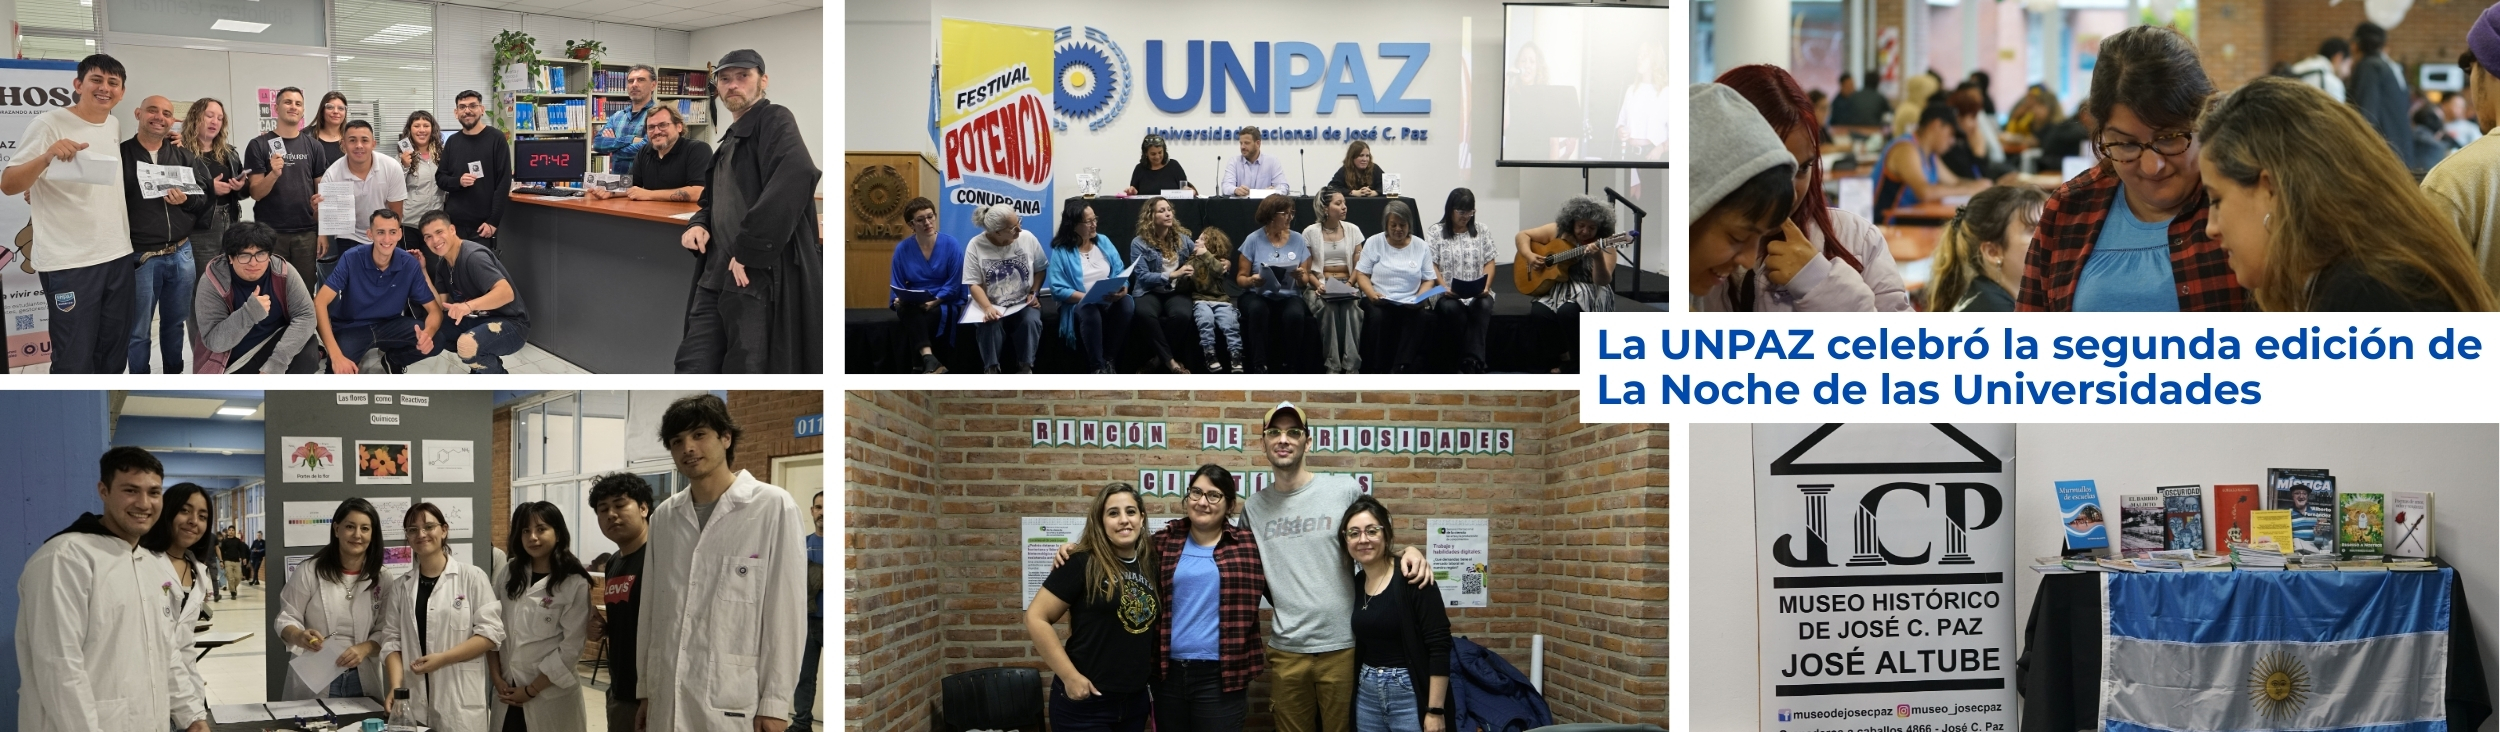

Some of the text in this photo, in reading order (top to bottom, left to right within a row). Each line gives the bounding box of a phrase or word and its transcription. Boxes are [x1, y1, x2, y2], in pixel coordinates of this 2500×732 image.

[1145, 39, 1432, 114] UNPAZ
[957, 66, 1030, 109] FESTIVAL
[261, 106, 270, 114] NO
[945, 94, 1052, 185] POTENCIA
[1257, 126, 1319, 140] acional
[1322, 127, 1342, 141] de
[1344, 126, 1378, 143] José
[1382, 127, 1396, 141] C.
[1401, 127, 1428, 141] Paz
[529, 153, 570, 167] 27:42
[855, 223, 904, 237] UNPAZ
[350, 394, 367, 402] flores
[401, 395, 428, 404] Reactivos
[797, 416, 823, 435] 011
[1037, 422, 1509, 449] RINCÓN DE RIOSIDADES
[2165, 487, 2200, 497] OSCURIDAD
[1772, 481, 2003, 568] JCP
[1779, 588, 2000, 614] MUSEO HISTÓRICO
[1799, 615, 1983, 640] DE JOSÉ C. PAZ
[1781, 646, 2000, 678] JOSÉ ALTUBE
[1793, 703, 2002, 720] museodejosecpaz museo_josecpaz
[1941, 722, 1968, 732] José
[1985, 721, 2005, 731] Paz
